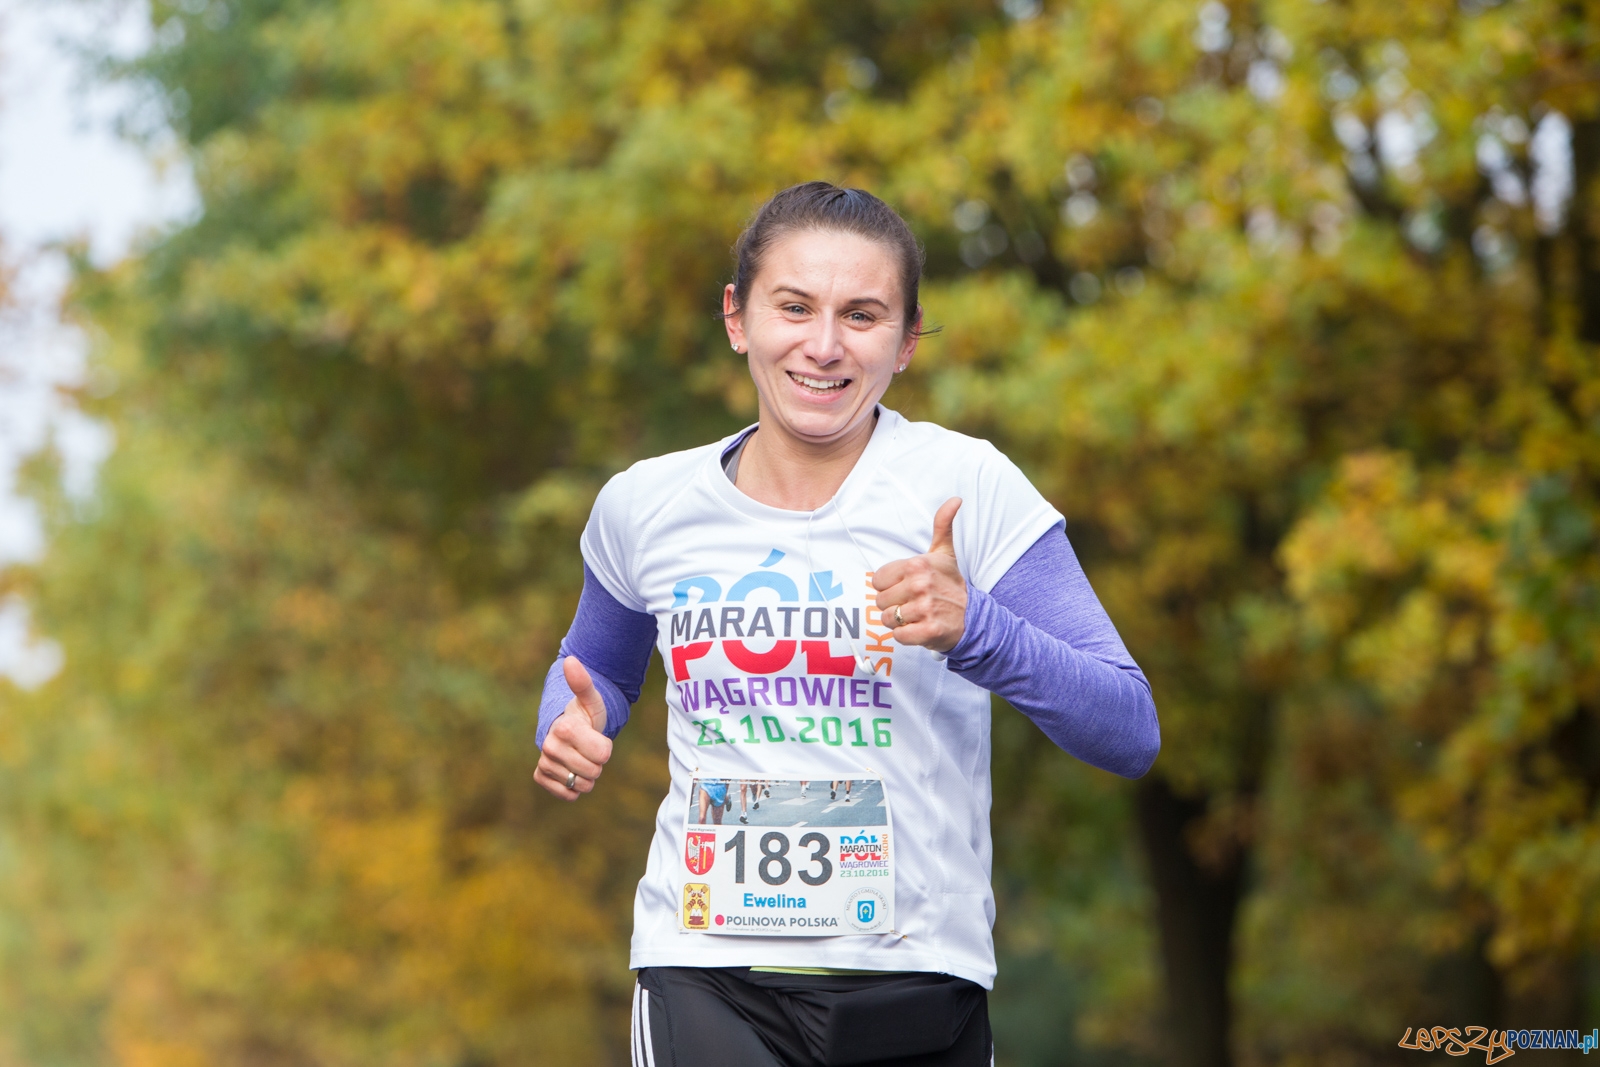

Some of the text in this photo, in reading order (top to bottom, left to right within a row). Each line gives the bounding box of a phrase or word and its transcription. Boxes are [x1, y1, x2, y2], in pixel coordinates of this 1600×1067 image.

[670, 606, 860, 645] MARATON
[676, 676, 893, 715] WĄGROWIEC
[691, 714, 892, 748] 23.10.2016
[840, 844, 882, 853] MARATON
[724, 830, 833, 886] 183
[839, 860, 889, 870] WĄGROWIEC
[840, 869, 889, 878] 23.10.2016
[743, 893, 807, 909] Ewelina
[726, 916, 838, 927] POLINOVA POLSKA
